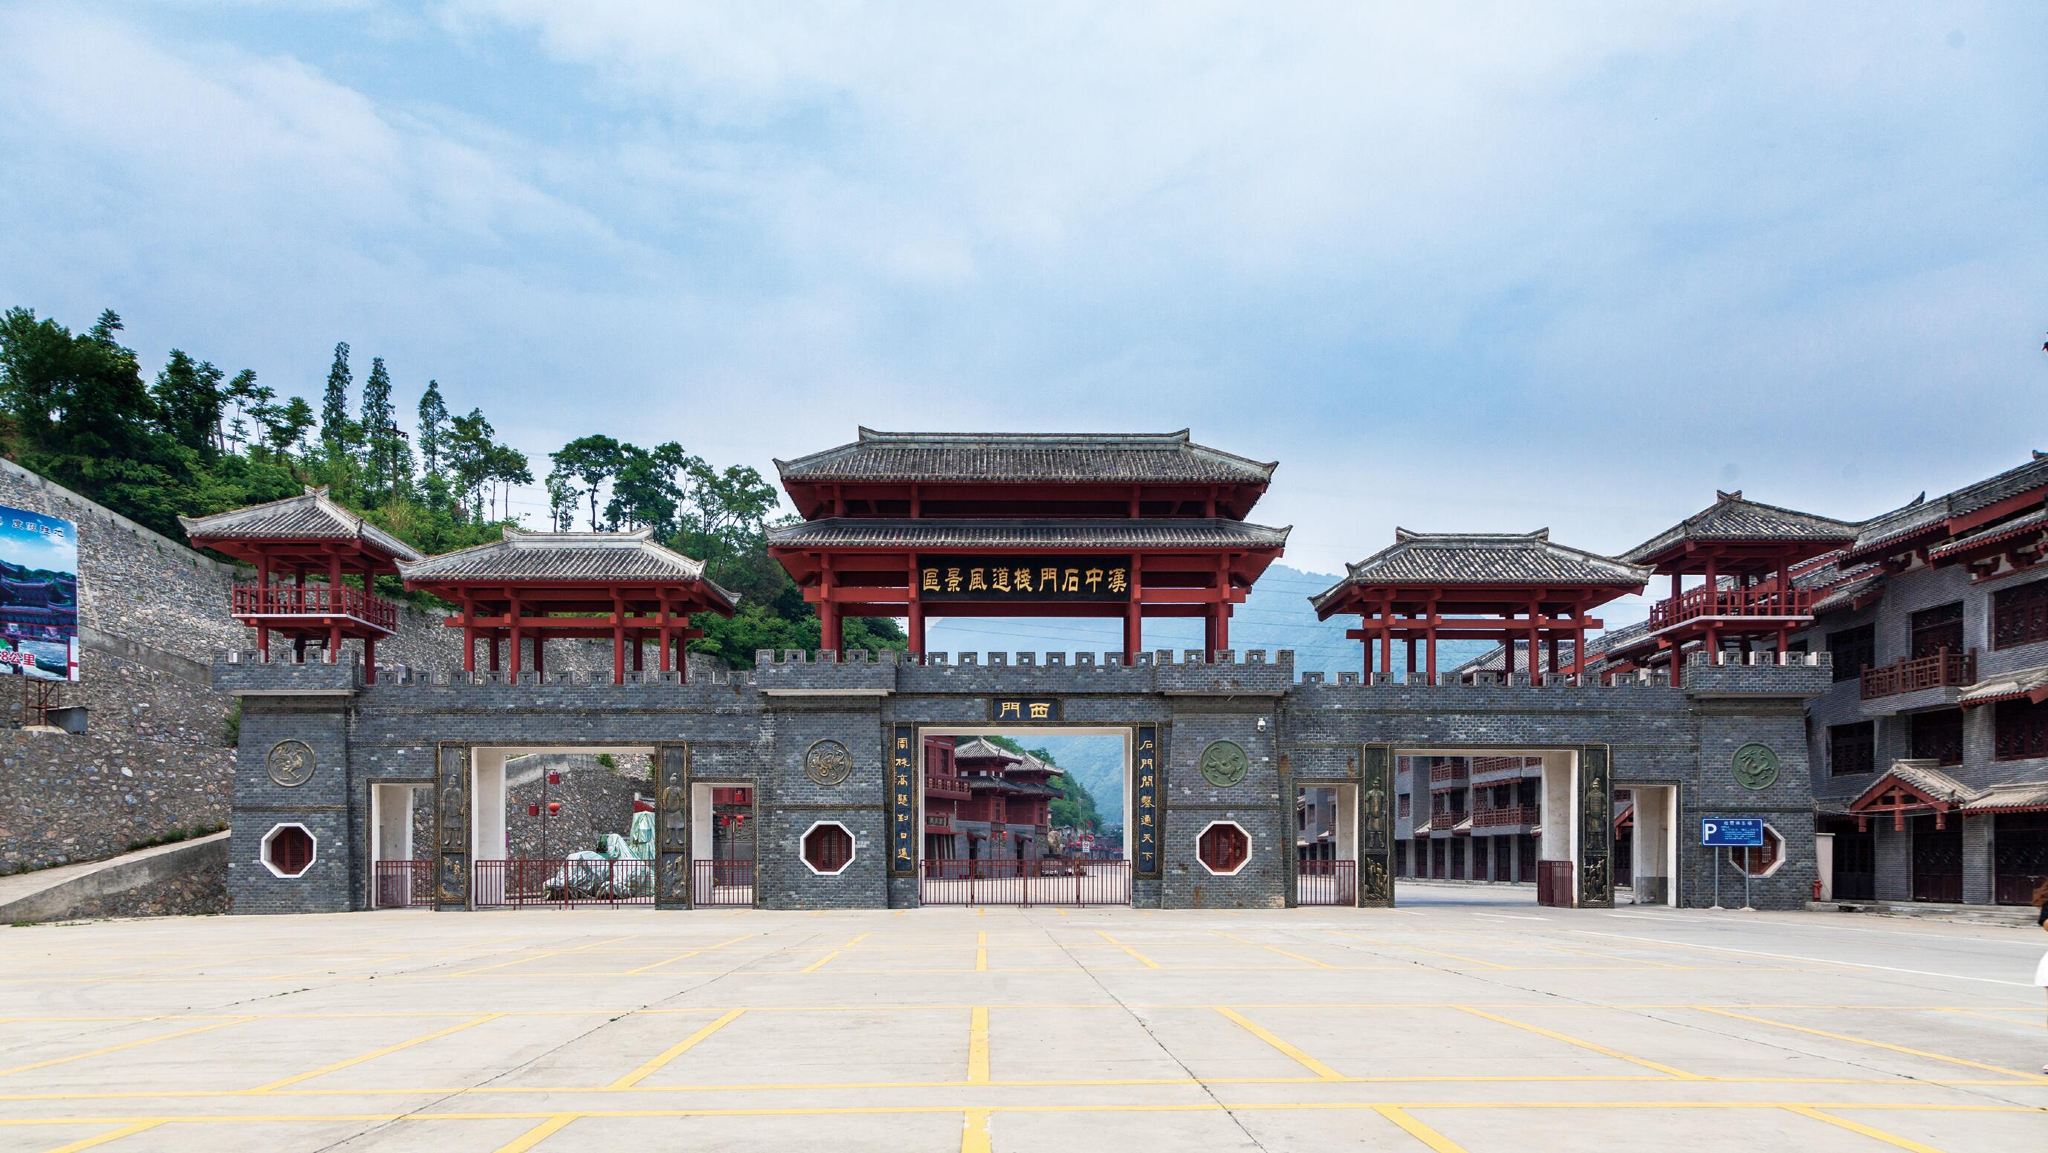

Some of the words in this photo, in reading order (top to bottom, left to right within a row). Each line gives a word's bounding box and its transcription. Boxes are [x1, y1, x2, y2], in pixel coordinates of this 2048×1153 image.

[922, 567, 1127, 593] 漢中石門棧道風景區
[999, 701, 1051, 719] 西門
[1704, 823, 1717, 840] P
